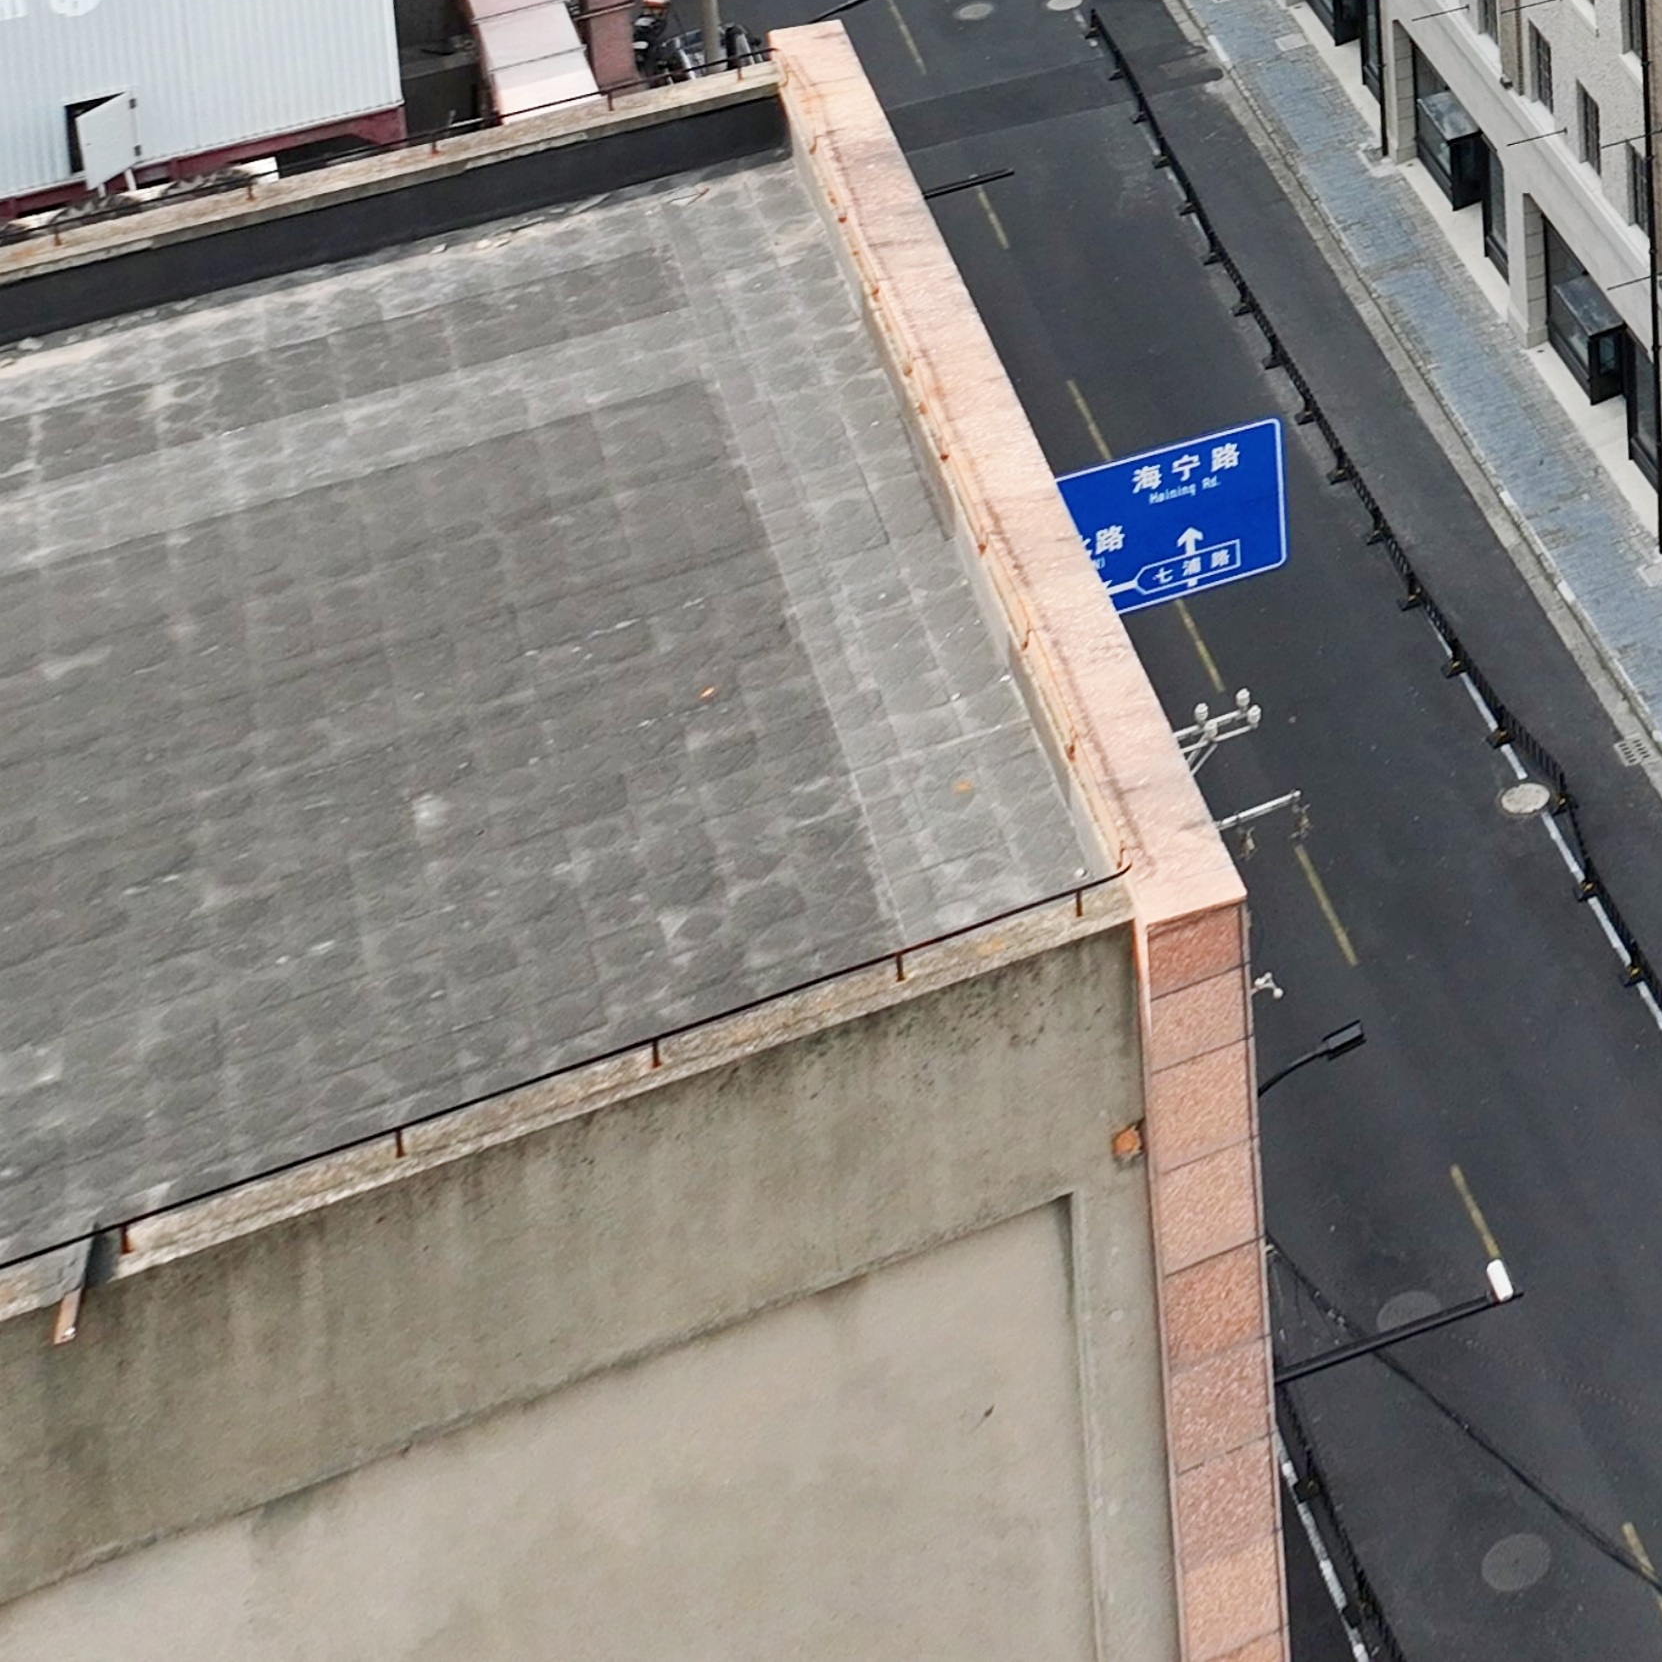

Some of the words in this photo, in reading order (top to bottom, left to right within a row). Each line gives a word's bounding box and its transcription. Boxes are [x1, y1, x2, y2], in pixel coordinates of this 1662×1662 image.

[1132, 442, 1241, 493] 海宁路
[1149, 482, 1197, 505] Haining
[1201, 474, 1221, 490] Rd.
[1152, 548, 1231, 584] 七浦路
